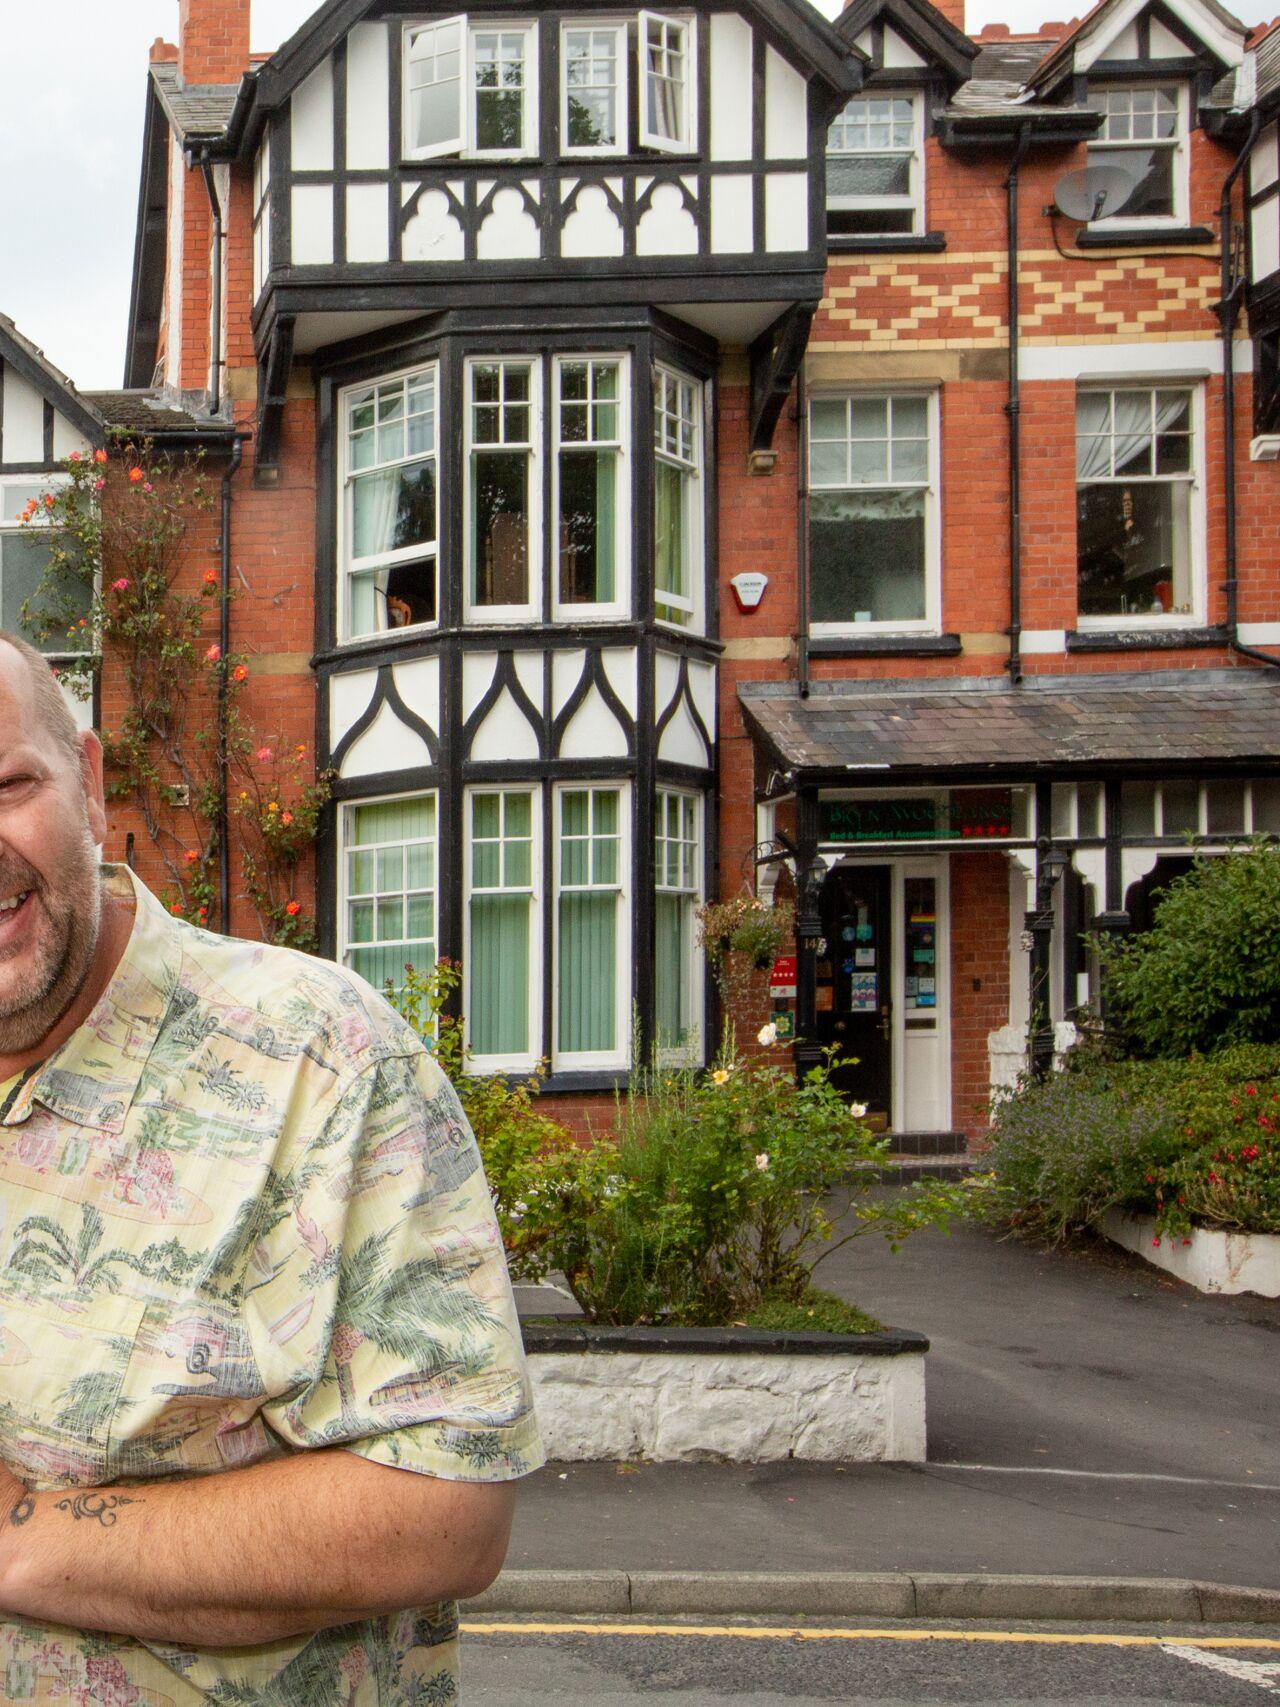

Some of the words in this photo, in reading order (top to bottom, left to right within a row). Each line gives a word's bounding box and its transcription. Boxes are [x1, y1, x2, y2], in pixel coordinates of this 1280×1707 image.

[830, 832, 846, 840] Bed
[856, 831, 894, 840] Breakfast
[895, 829, 961, 839] Accommodation
